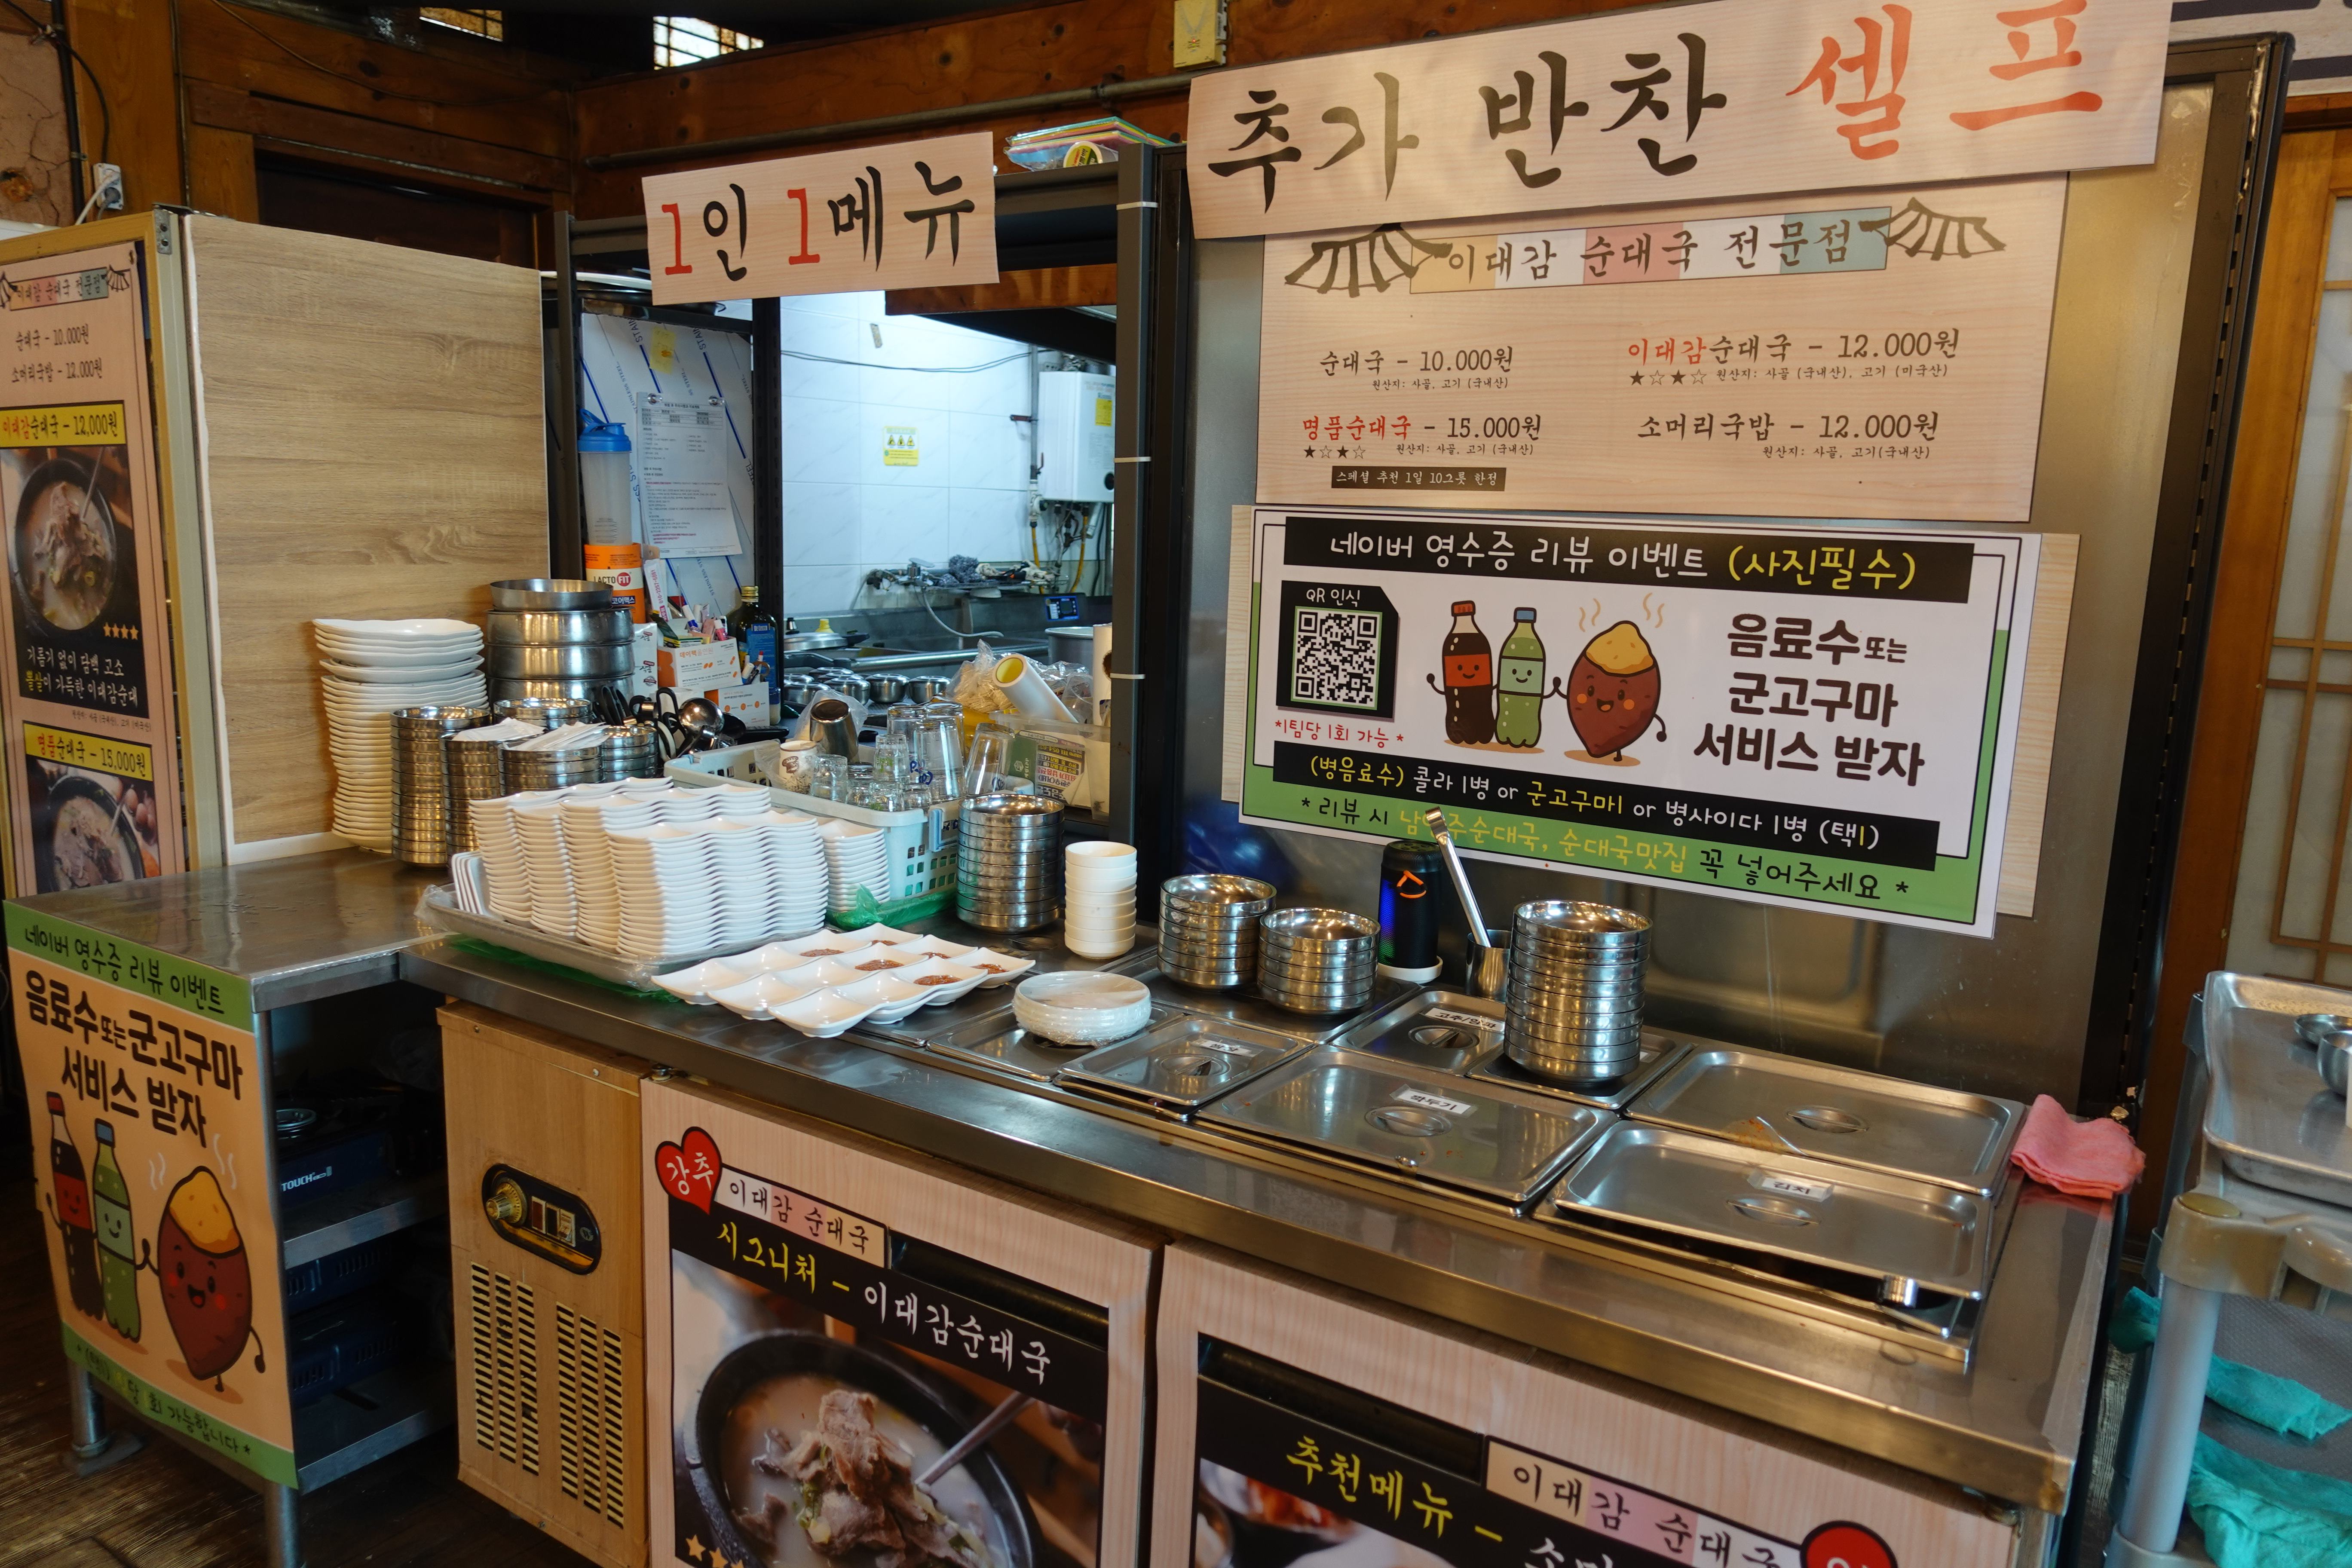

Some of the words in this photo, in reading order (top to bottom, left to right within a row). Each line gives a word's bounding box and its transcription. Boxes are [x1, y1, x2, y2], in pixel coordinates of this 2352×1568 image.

[1208, 72, 1419, 214] 추가
[1479, 33, 1727, 188] 반찬
[1785, 0, 2102, 160] 셀프
[662, 183, 747, 282] 1인
[787, 161, 975, 272] 1메뉴
[1449, 239, 1557, 283] 이대감
[1580, 230, 1698, 278] 순대국
[1724, 219, 1850, 269] 전문점
[15, 329, 40, 352] 순대국
[1628, 334, 1792, 365] 이대감순대국
[1838, 328, 1959, 359] 12.000원
[12, 362, 53, 383] 소머리국밥
[1320, 350, 1384, 376] 순대국
[1420, 346, 1513, 373] 10.000원
[1717, 368, 1757, 381] 원산지:
[1765, 367, 1789, 380] 사골
[1861, 365, 1886, 378] 고기
[1896, 364, 1948, 378] (미국산)
[1372, 379, 1406, 390] 원산지:
[1442, 378, 1460, 389] 고기
[1468, 377, 1508, 389] (국내산)
[1303, 415, 1411, 441] 명품순대국
[1448, 414, 1541, 440] 15.000원
[1638, 413, 1775, 441] 소머리국밥
[1819, 411, 1939, 441] 12.000원
[1396, 444, 1429, 455] 원산지:
[1467, 444, 1485, 454] 고기
[1493, 444, 1533, 456] (국내산)
[1762, 446, 1804, 459] 원산지:
[1336, 470, 1369, 483] 스페셜
[1377, 470, 1399, 484] 추천
[1406, 471, 1422, 484] 1일
[1430, 471, 1466, 486] 10그릇
[1475, 472, 1496, 486] 한정
[1331, 531, 1412, 558] 네이버
[1426, 531, 1515, 571] 영수증
[1531, 536, 1593, 574] 리뷰
[1608, 543, 1708, 579] 이벤트
[1729, 545, 1916, 590] (사진필수)
[618, 576, 630, 584] FIT
[1306, 588, 1325, 603] QR
[1331, 588, 1360, 607] 인식
[1727, 613, 1860, 665] 음료수
[1864, 637, 1907, 663] 또는
[104, 658, 124, 677] 고소
[55, 674, 84, 699] 가득한
[1729, 672, 1899, 728] 군고구마
[1329, 723, 1349, 741] 1회
[1358, 728, 1389, 748] 가능
[1694, 723, 1818, 772] 서비스
[1834, 736, 1925, 787] 받자
[1311, 756, 1404, 787] (병음료수)
[1413, 766, 1453, 793] 콜라
[1463, 777, 1489, 800] 1병
[1498, 786, 1518, 800] or
[1634, 804, 1656, 818] or
[1666, 801, 1762, 831] 병사이다
[1774, 815, 1807, 842] 1병
[1319, 798, 1360, 824] 리뷰
[1369, 808, 1388, 825] 시
[1559, 829, 1686, 873] 순대국맛집
[1700, 848, 1724, 879] 꼭
[1738, 854, 1880, 900] 넣어주세요
[25, 925, 69, 956] 네이버
[75, 939, 121, 982] 영수증
[131, 956, 163, 995] 리뷰
[170, 975, 224, 1014] 이벤트
[26, 970, 98, 1044] 음료수
[101, 1015, 126, 1050] 또는
[129, 1010, 243, 1100] 군고구마
[62, 1045, 139, 1118] 서비스
[147, 1077, 207, 1148] 받자
[1411, 1094, 1457, 1111] 깍두기
[282, 1173, 315, 1191] TOUCH
[667, 1152, 714, 1196] 강추
[729, 1179, 793, 1225] 이대감
[804, 1209, 870, 1255] 순대국
[717, 1222, 816, 1293] 시그니처
[864, 1282, 1052, 1386] 이대감순대국
[1287, 1434, 1454, 1538] 추천메뉴
[1514, 1464, 1631, 1531] 이대감
